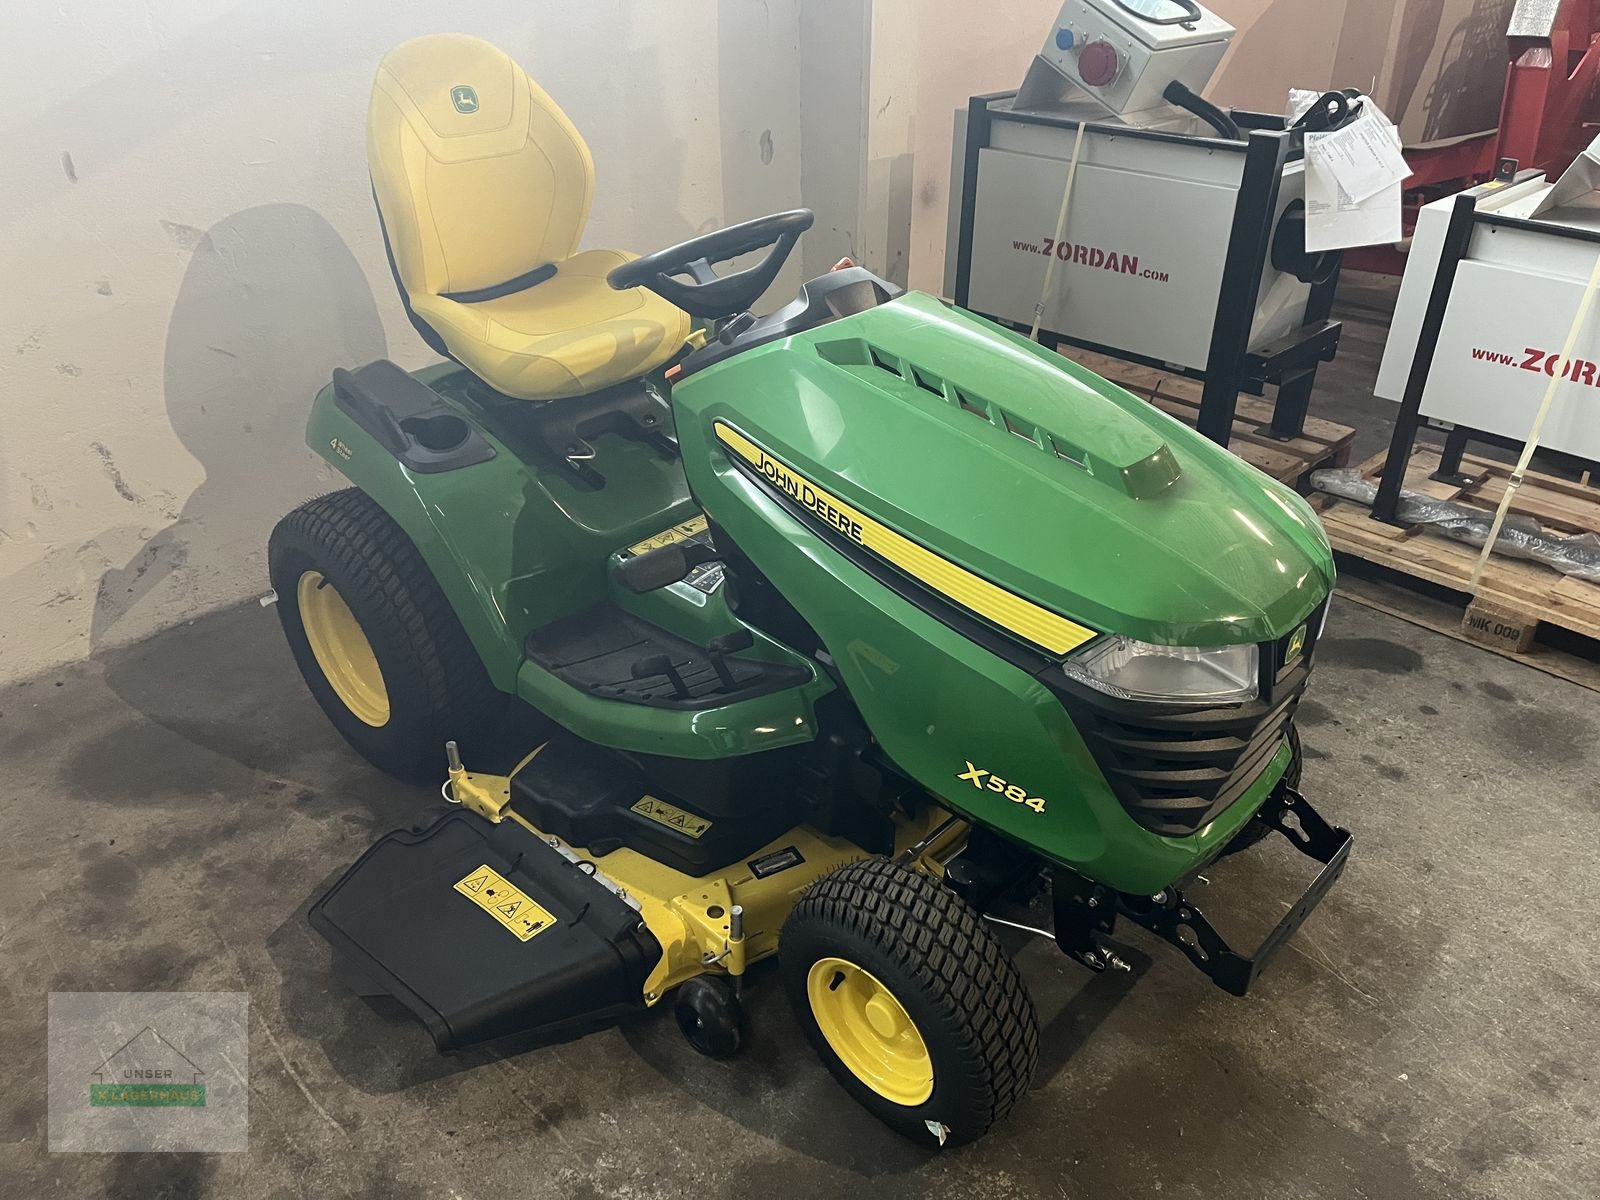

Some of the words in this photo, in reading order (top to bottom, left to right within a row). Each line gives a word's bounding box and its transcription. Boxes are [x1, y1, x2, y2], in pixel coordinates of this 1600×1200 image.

[1472, 348, 1600, 388] www.ZOR
[330, 438, 338, 449] 4
[755, 453, 799, 498] JOHN
[802, 485, 863, 543] DEERE
[956, 760, 1047, 813] X584
